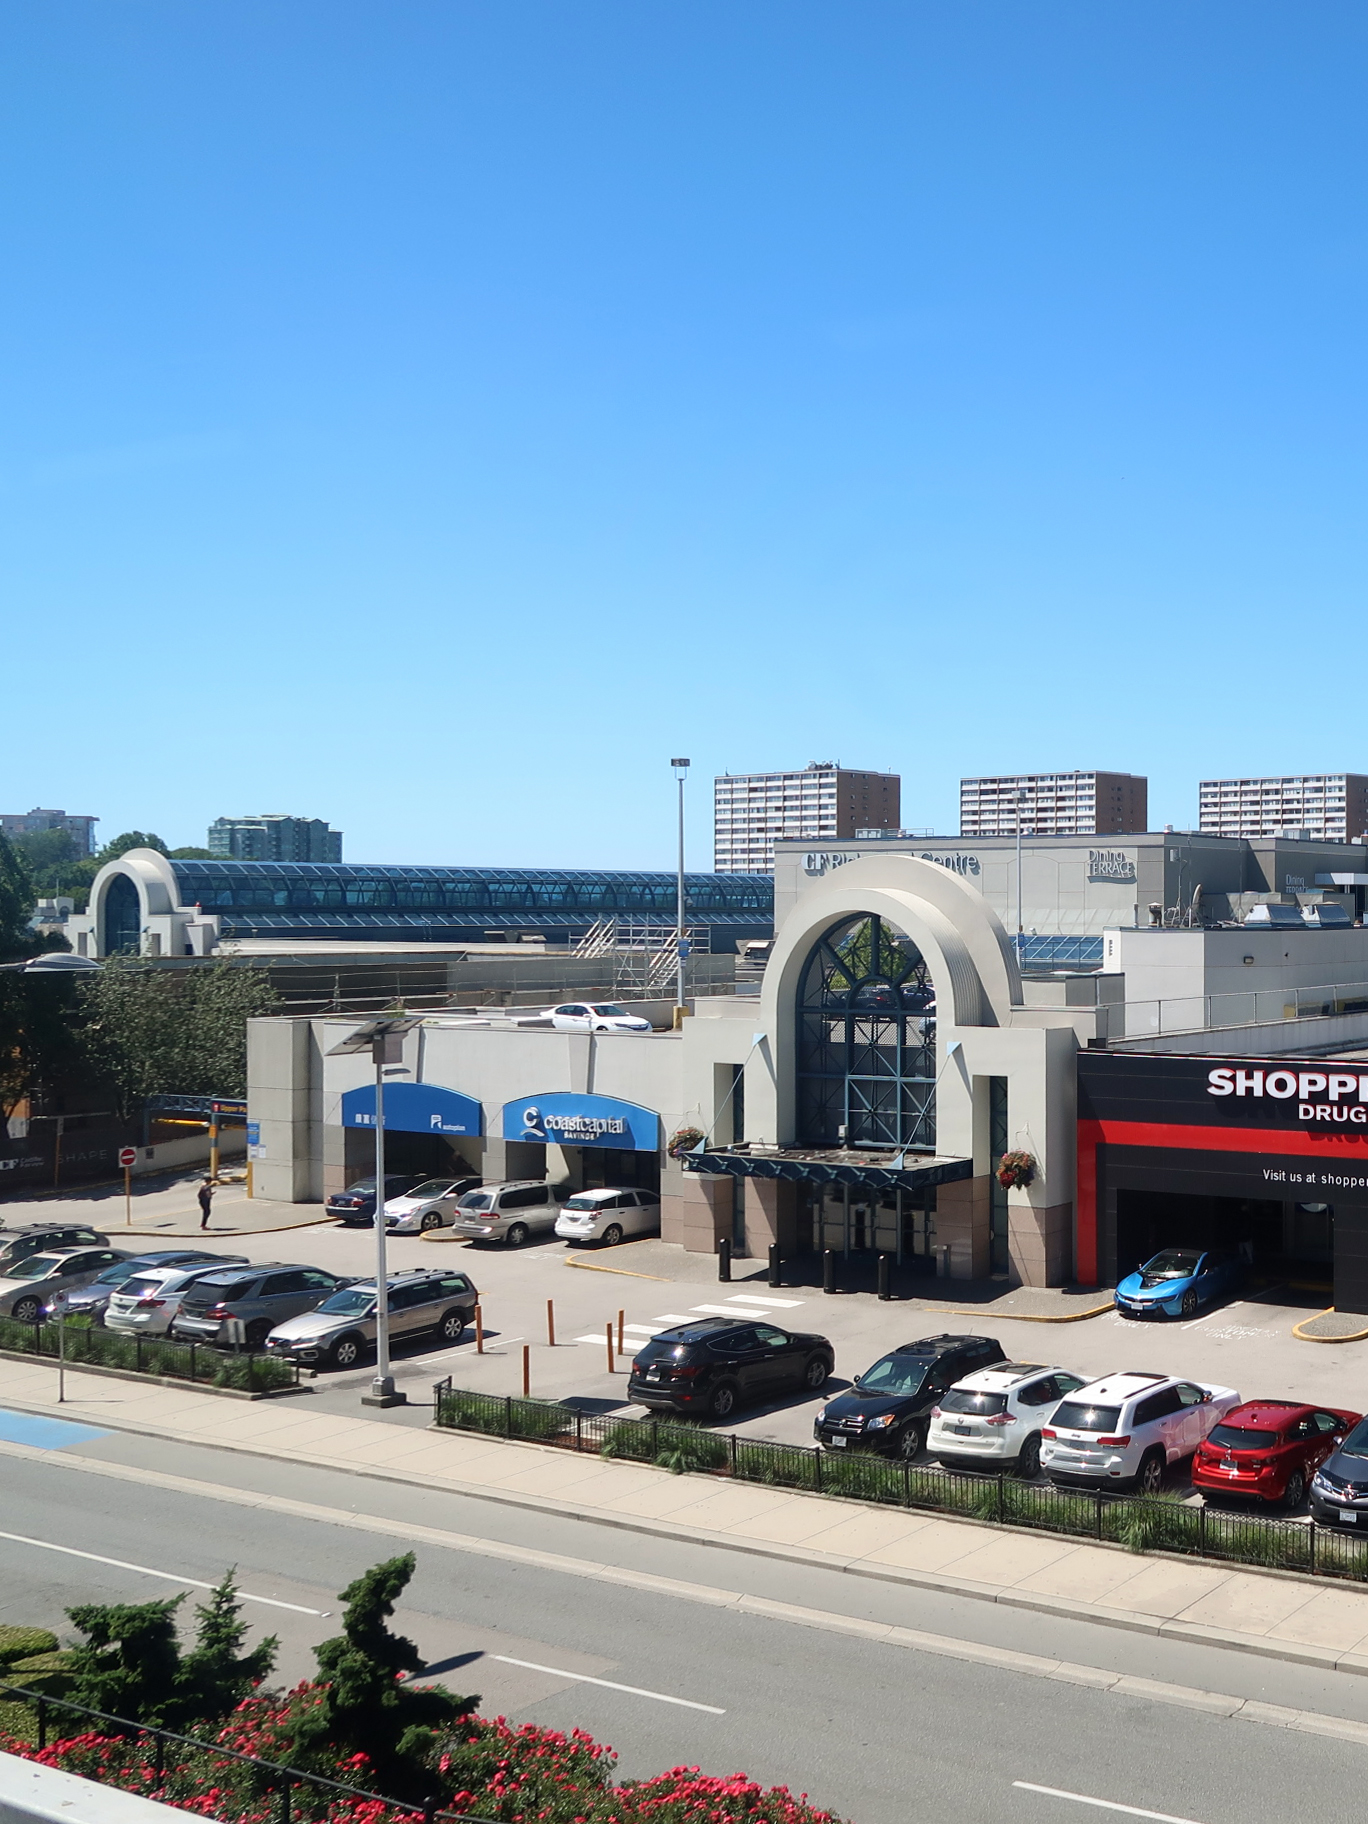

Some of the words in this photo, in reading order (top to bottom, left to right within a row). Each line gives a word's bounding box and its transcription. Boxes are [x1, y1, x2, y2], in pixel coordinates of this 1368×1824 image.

[1088, 849, 1123, 863] Dining
[1088, 861, 1133, 876] TERRACE
[1298, 1103, 1367, 1124] DRUG
[1263, 1169, 1286, 1182] Visit
[1289, 1173, 1302, 1182] us
[1306, 1172, 1316, 1184] at
